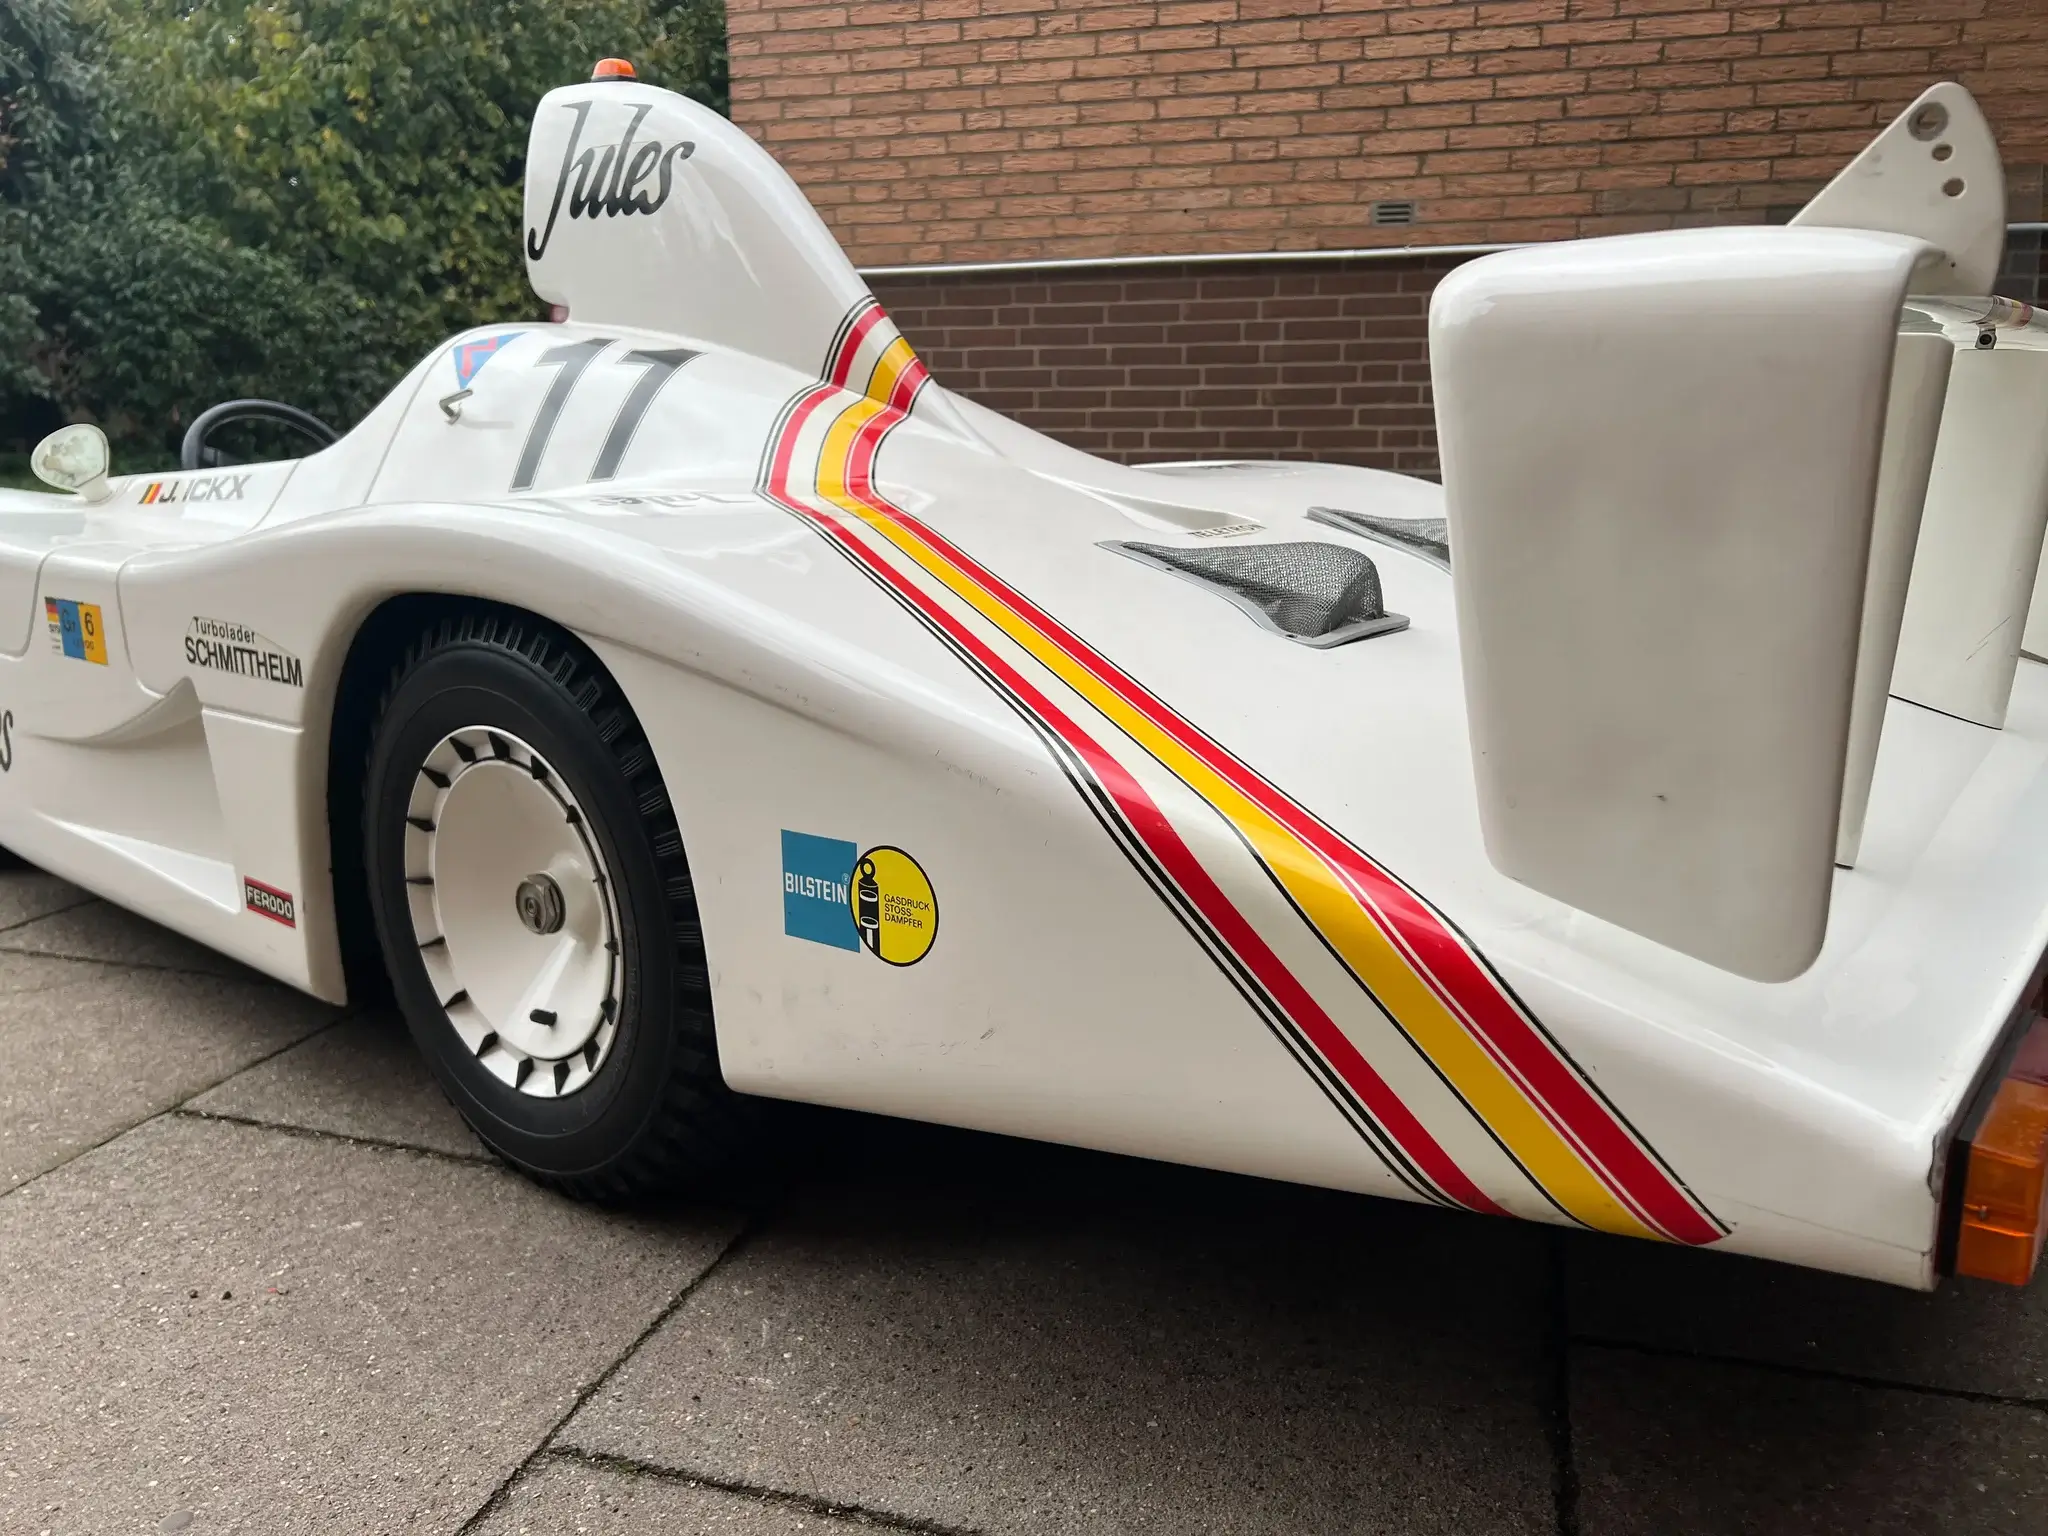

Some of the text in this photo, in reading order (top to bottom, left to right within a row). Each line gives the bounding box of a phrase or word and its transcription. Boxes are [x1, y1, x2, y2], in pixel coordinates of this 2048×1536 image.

[528, 101, 695, 260] Jules
[182, 475, 252, 502] ICKX
[84, 611, 95, 637] 6
[193, 616, 256, 645] Turbolader
[185, 636, 304, 688] SCHMITTHELM
[247, 885, 293, 919] FERODO
[784, 872, 848, 905] BILSTEIN
[884, 893, 931, 912] GASDRUCK
